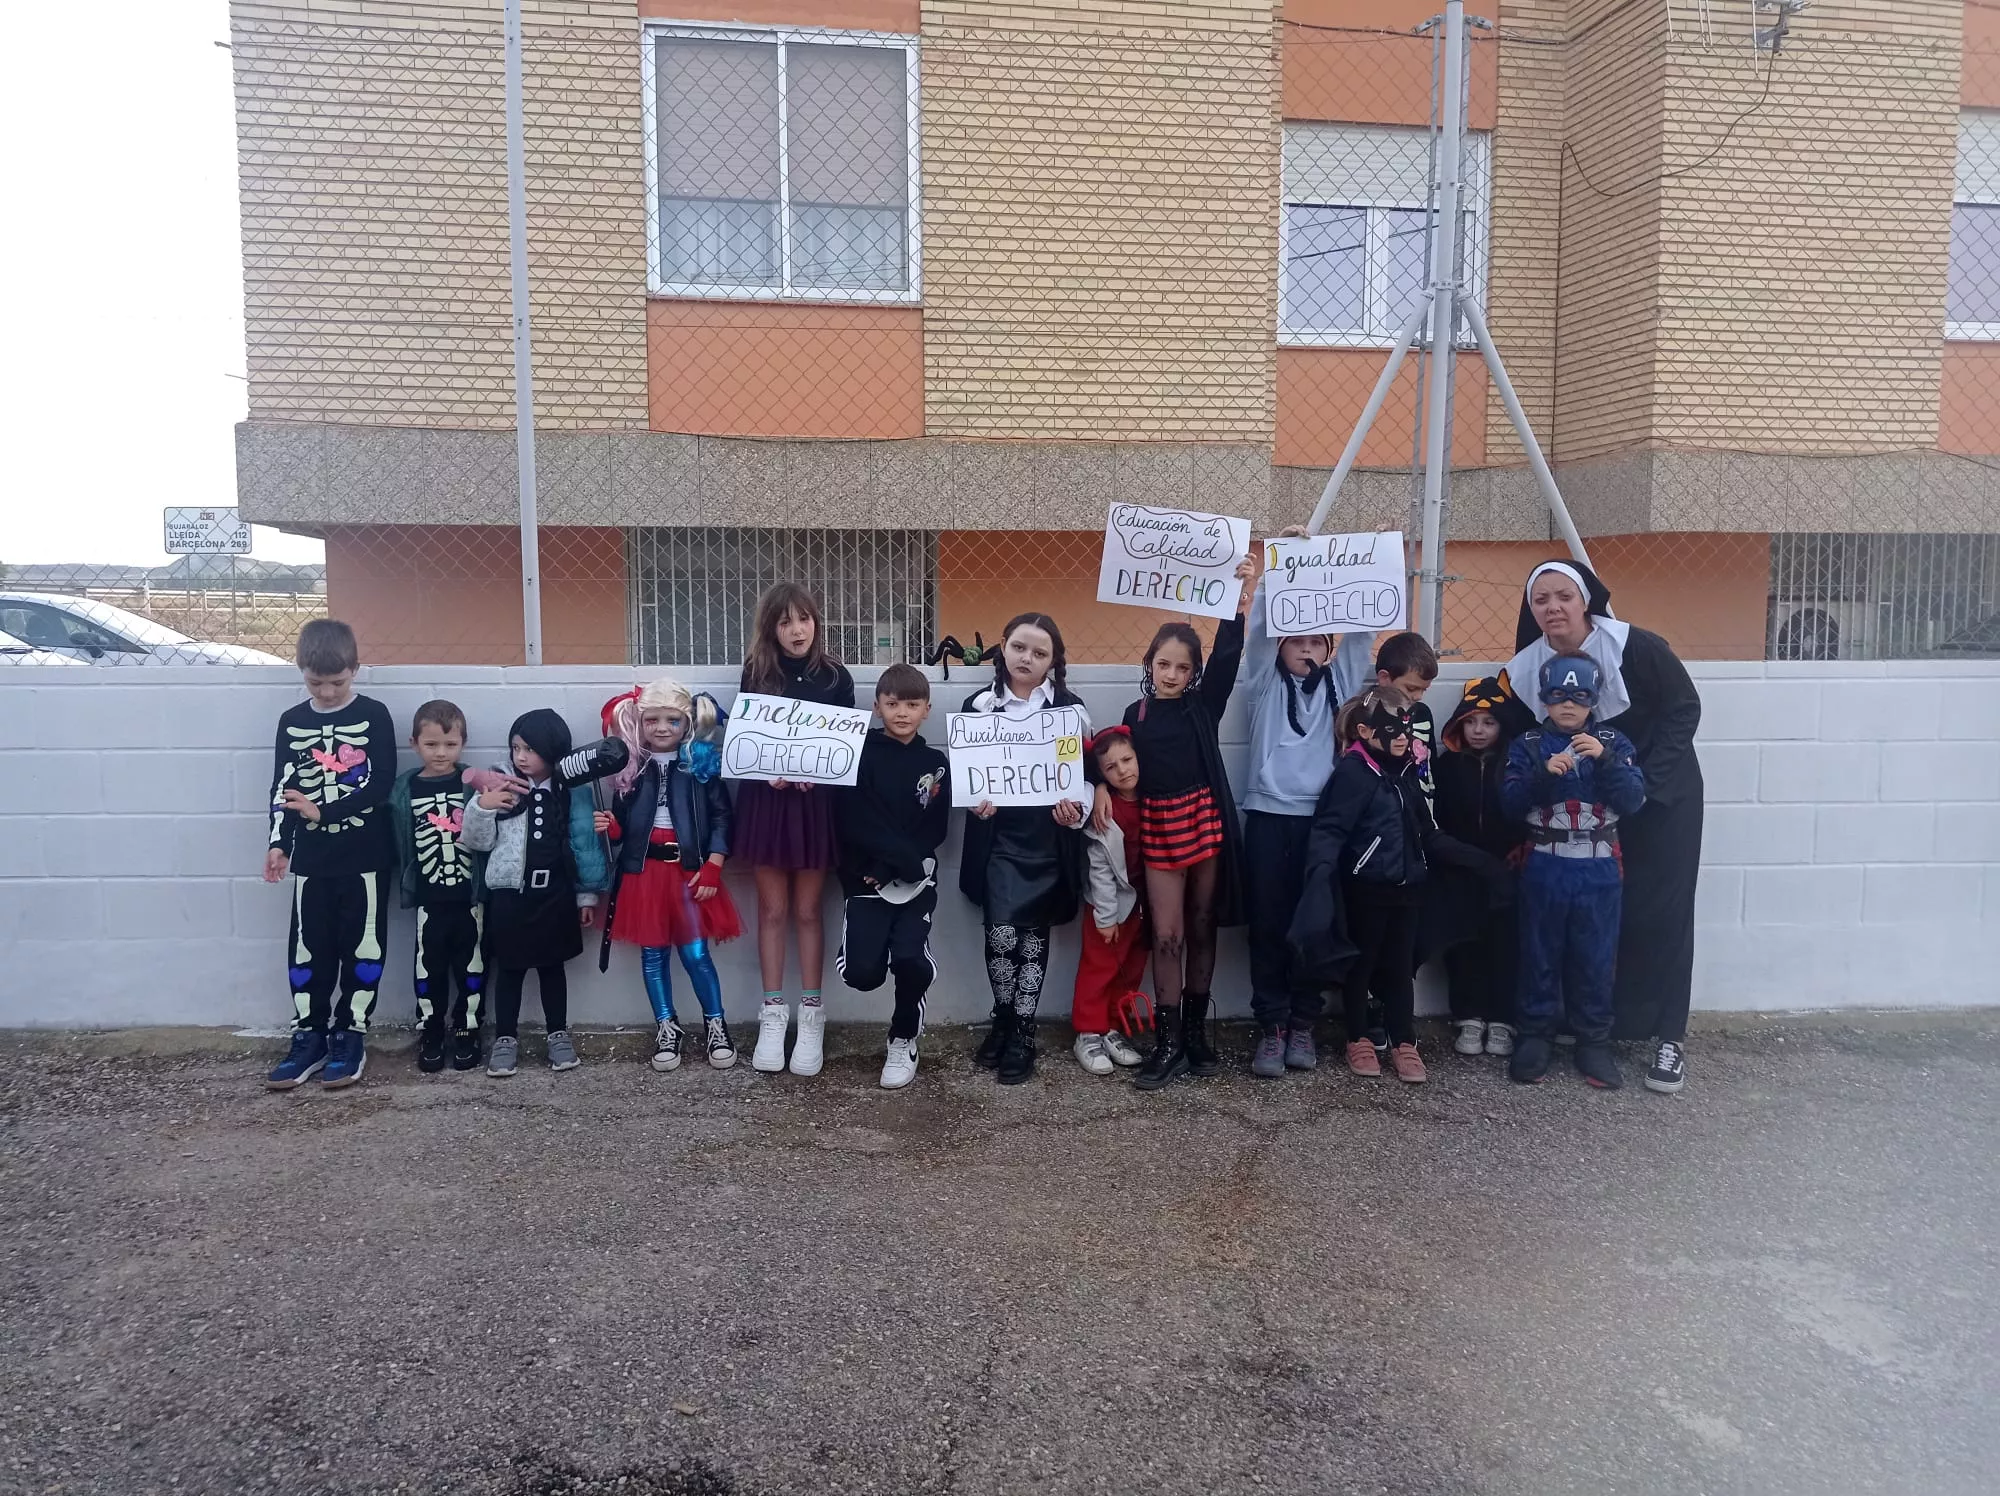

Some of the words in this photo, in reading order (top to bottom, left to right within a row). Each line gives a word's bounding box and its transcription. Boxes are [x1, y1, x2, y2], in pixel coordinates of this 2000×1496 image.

[169, 531, 201, 539] LLEIDA
[234, 531, 248, 539] 112
[1116, 506, 1190, 534] Educación
[1204, 519, 1221, 538] de
[169, 540, 226, 548] BARCELONA
[231, 540, 248, 548] 269
[1130, 531, 1219, 559] Calidad
[1266, 537, 1377, 583] Igualdad
[1115, 569, 1226, 606] DERECHO
[1281, 588, 1397, 625] DERECHO
[1562, 670, 1579, 687] A
[733, 698, 867, 736] Inclusión
[951, 716, 1035, 744] Auxiliares
[735, 737, 849, 775] DERECHO
[1058, 738, 1078, 756] 20
[559, 751, 590, 779] 1000
[968, 762, 1072, 795] DERECHO
